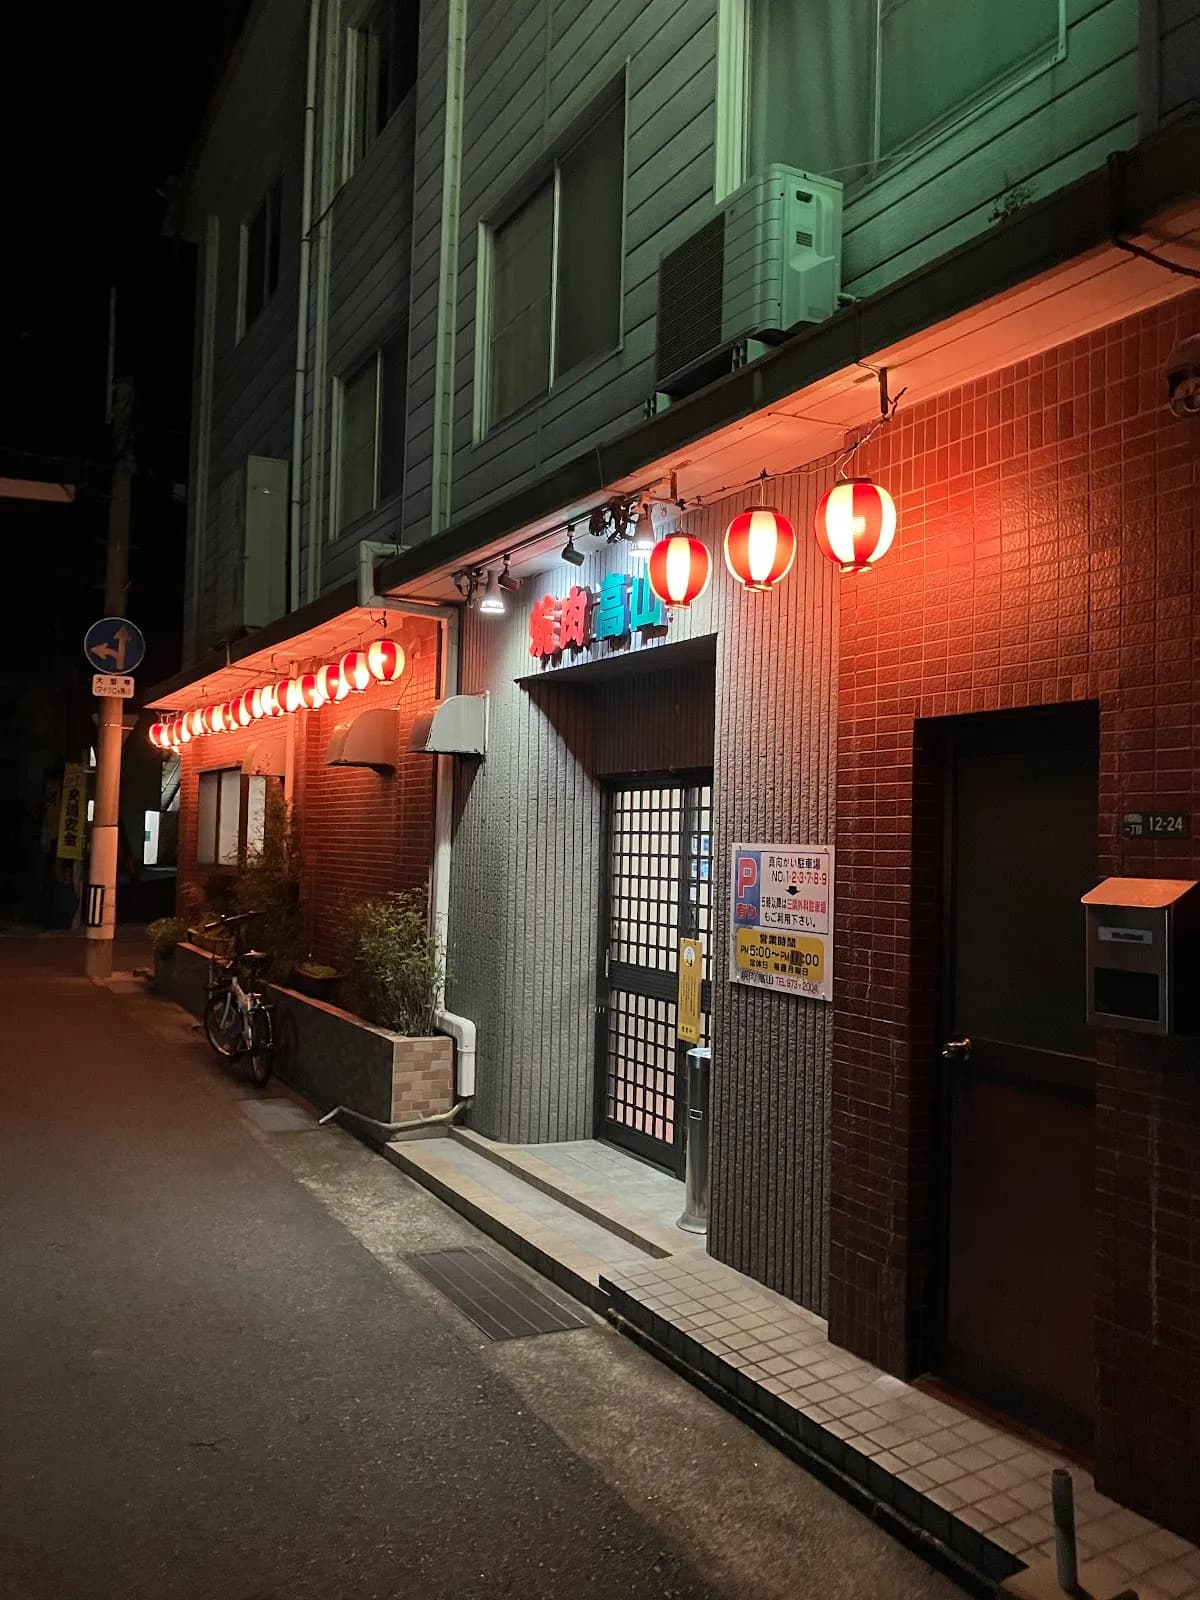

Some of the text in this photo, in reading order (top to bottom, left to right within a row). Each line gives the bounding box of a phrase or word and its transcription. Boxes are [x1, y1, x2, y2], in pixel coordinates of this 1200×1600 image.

[1149, 816, 1184, 831] 12-24
[768, 856, 821, 870] 真向かい駐車場
[738, 858, 757, 898] P
[759, 934, 796, 948] 営業時間
[749, 958, 809, 976] 定休日 毎週月曜日
